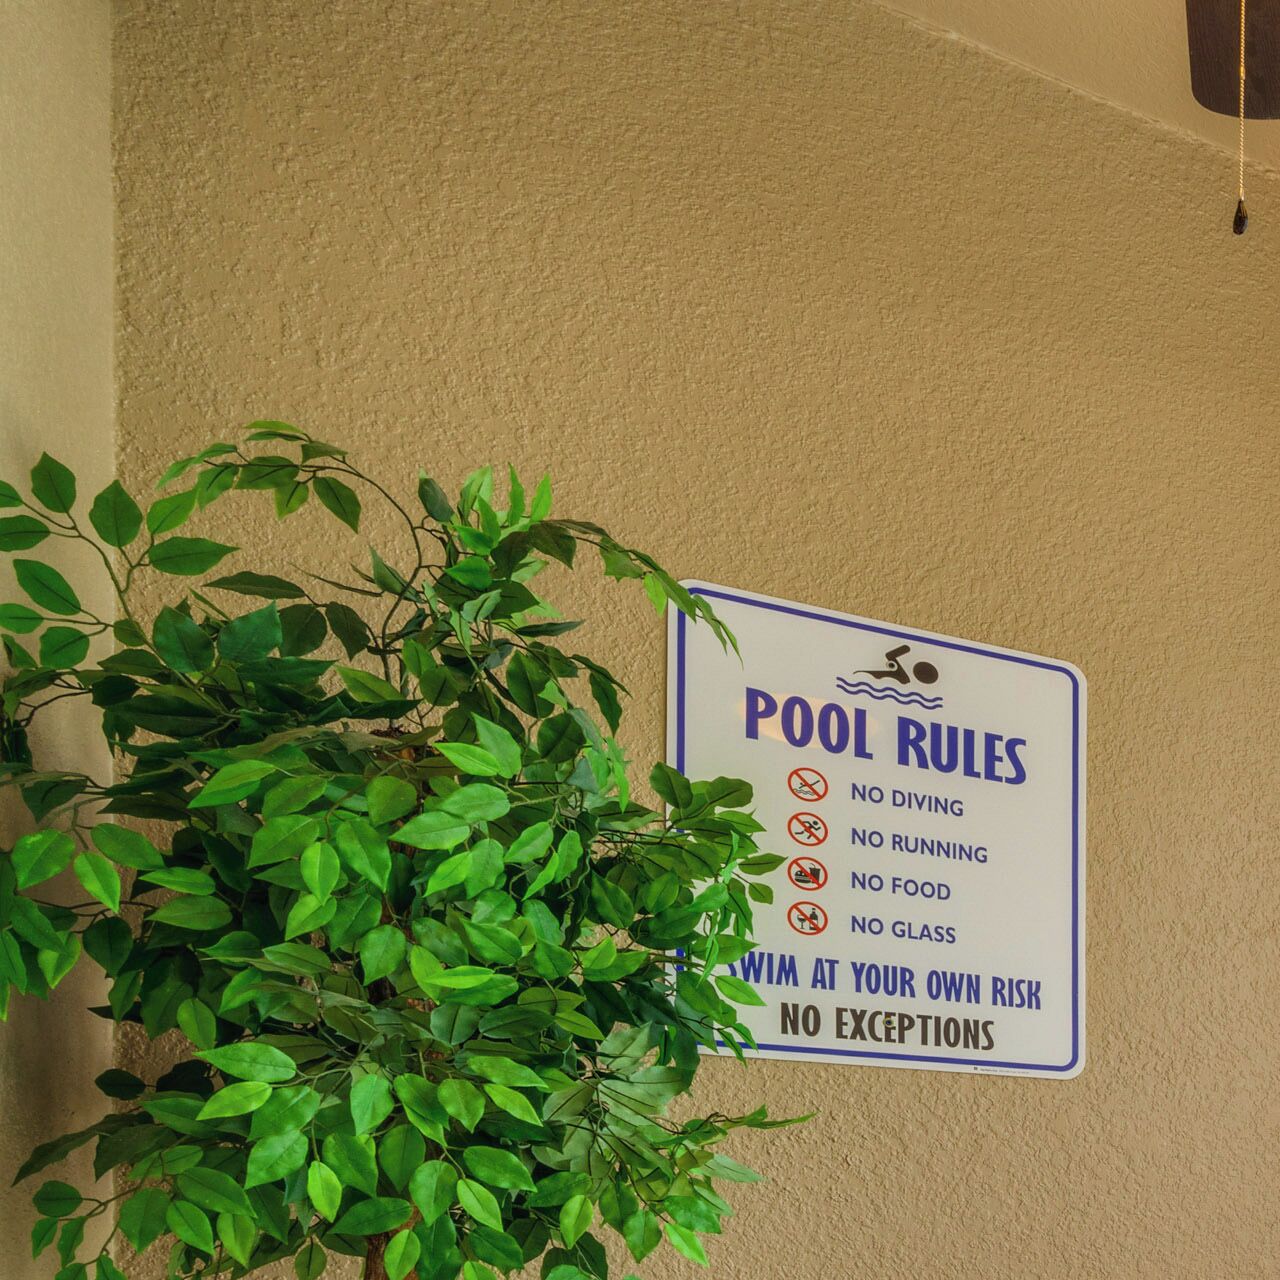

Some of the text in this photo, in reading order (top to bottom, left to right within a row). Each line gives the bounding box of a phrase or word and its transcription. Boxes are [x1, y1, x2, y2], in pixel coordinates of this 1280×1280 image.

[745, 686, 1027, 785] POOL RULES
[851, 783, 964, 817] NO DIVING
[851, 827, 988, 864] NO RUNNING
[851, 871, 951, 901] NO FOOD
[851, 916, 956, 944] NO GLASS
[812, 957, 839, 991] AT
[851, 961, 915, 998] YOUR
[927, 970, 980, 1004] OWN
[992, 977, 1041, 1010] RISK
[780, 1002, 995, 1051] NO EXCEPTIONS
